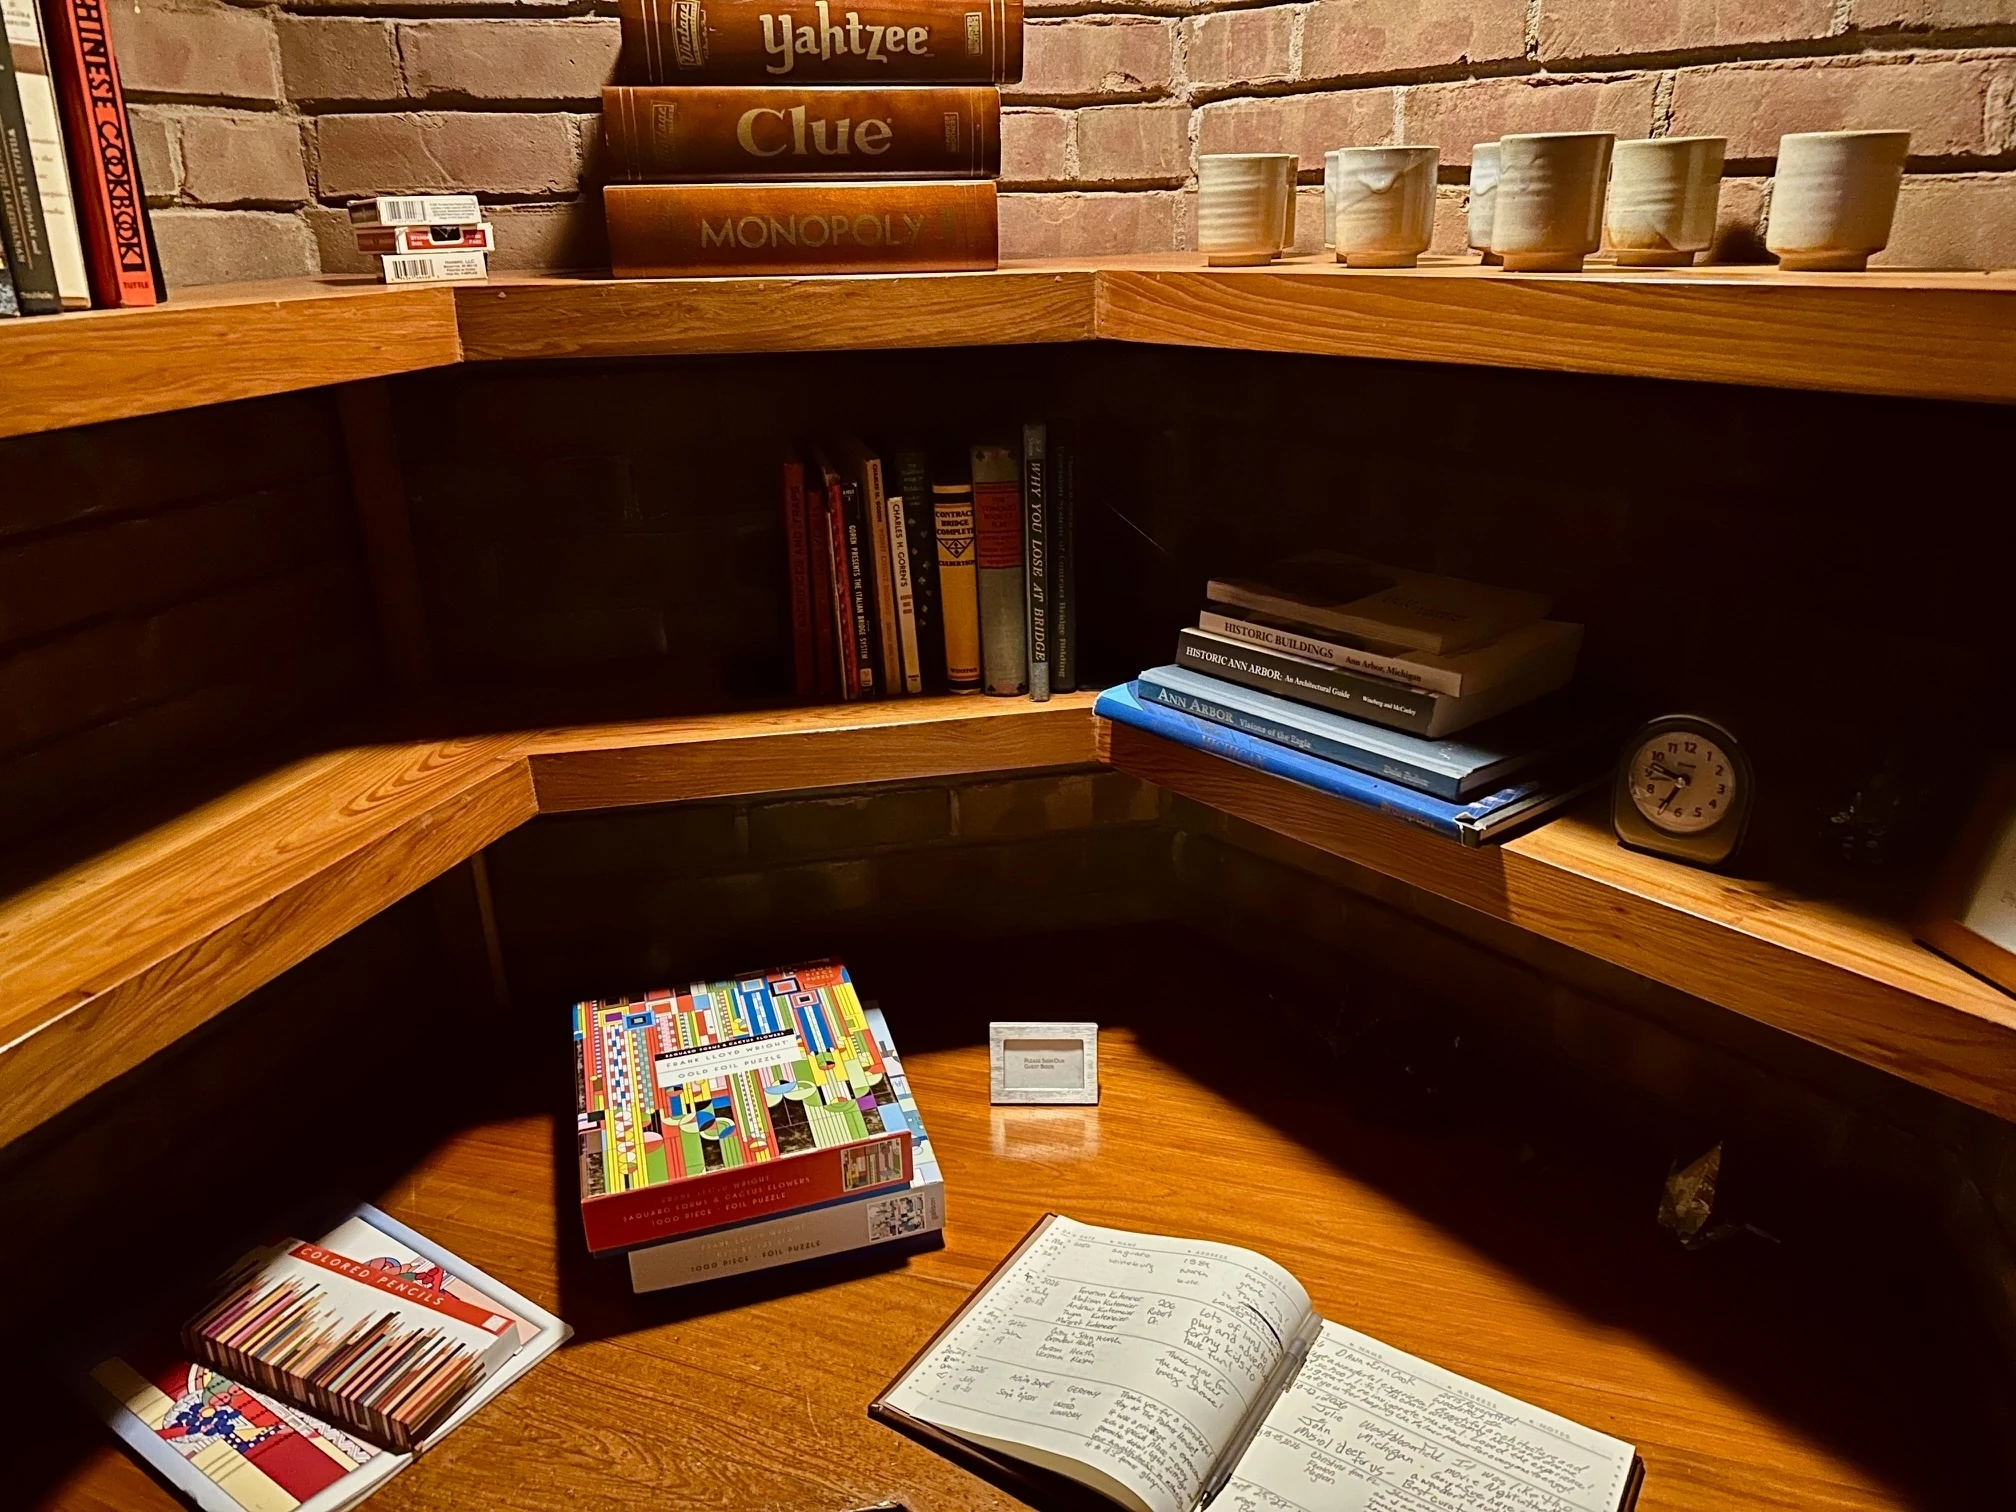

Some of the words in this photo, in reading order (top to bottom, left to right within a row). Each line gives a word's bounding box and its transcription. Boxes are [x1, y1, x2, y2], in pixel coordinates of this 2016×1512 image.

[74, 0, 117, 109] HINESE
[98, 120, 144, 264] COOKBOOK
[736, 104, 893, 157] Clue
[701, 213, 925, 249] MONOPOLY
[123, 281, 149, 290] TUTTLE
[1030, 462, 1042, 498] WHY
[936, 510, 975, 518] CONTRAC
[941, 519, 969, 527] BRIDGE
[1031, 503, 1043, 533] YOU
[849, 524, 857, 546] GOREN
[892, 503, 903, 538] CHARLES
[898, 552, 909, 587] GOREN'S
[851, 547, 860, 577] PRESENTS
[1032, 539, 1044, 578] LOSE
[855, 591, 864, 613] ITALIAN
[1032, 582, 1044, 603] AT
[857, 615, 867, 636] BRIDGE
[1034, 608, 1046, 662] BRIDGE
[859, 637, 868, 660] SYSTEM
[1224, 622, 1274, 643] HISTORIC
[1275, 635, 1334, 659] BUILDINGS
[1345, 655, 1361, 667] Ann
[1361, 660, 1385, 673] Arbor,
[1386, 666, 1422, 683] Michigan
[1186, 646, 1228, 666] HISTORIC
[1228, 658, 1248, 671] ANN
[1248, 664, 1282, 681] ARBOR:
[1284, 675, 1294, 683] An
[1294, 676, 1332, 694] Architectural
[1332, 687, 1350, 699] Guide
[1383, 701, 1393, 709] and
[1157, 687, 1187, 708] ANN
[1190, 698, 1235, 724] ARBOR
[1240, 719, 1266, 734] Visions
[1267, 729, 1277, 737] of
[1277, 730, 1290, 741] the
[1651, 751, 1665, 762] 10
[1668, 742, 1678, 754] 11
[1684, 742, 1697, 754] 12
[1706, 751, 1712, 762] 1
[1714, 765, 1724, 777] 2
[1646, 784, 1655, 795] 8
[1717, 784, 1726, 795] 3
[1673, 807, 1682, 818] 6
[1694, 807, 1702, 817] 5
[1708, 799, 1717, 809] 4
[666, 1057, 700, 1068] FRANK
[706, 1050, 740, 1060] LLOYD
[746, 1040, 786, 1053] WRIGHT
[678, 1068, 708, 1079] GOLD
[714, 1063, 739, 1072] FOIL
[744, 1054, 782, 1066] PUZZLE
[733, 1175, 770, 1189] WRIGHT
[623, 1206, 672, 1223] SAGUARO
[724, 1187, 763, 1201] CACTUS
[768, 1176, 811, 1191] FLOWERS
[652, 1215, 680, 1227] 1000
[685, 1208, 712, 1219] PIECE
[726, 1201, 747, 1211] FOIL
[752, 1191, 786, 1205] PUZZLE
[690, 1262, 718, 1273] 1000
[723, 1255, 749, 1266] PIECE
[762, 1250, 782, 1258] FOIL
[788, 1240, 821, 1252] PUZZLE
[1195, 1250, 1229, 1260] ADDRESS
[300, 1247, 371, 1278] COLORED
[376, 1276, 445, 1306] PENCILS
[1262, 1270, 1288, 1291] NOTES
[1199, 1307, 1223, 1324] Lots
[1227, 1321, 1242, 1333] of
[1243, 1330, 1262, 1353] land
[1215, 1327, 1237, 1344] and
[1457, 1389, 1498, 1410] ADDRESS
[1538, 1421, 1571, 1441] NOTES
